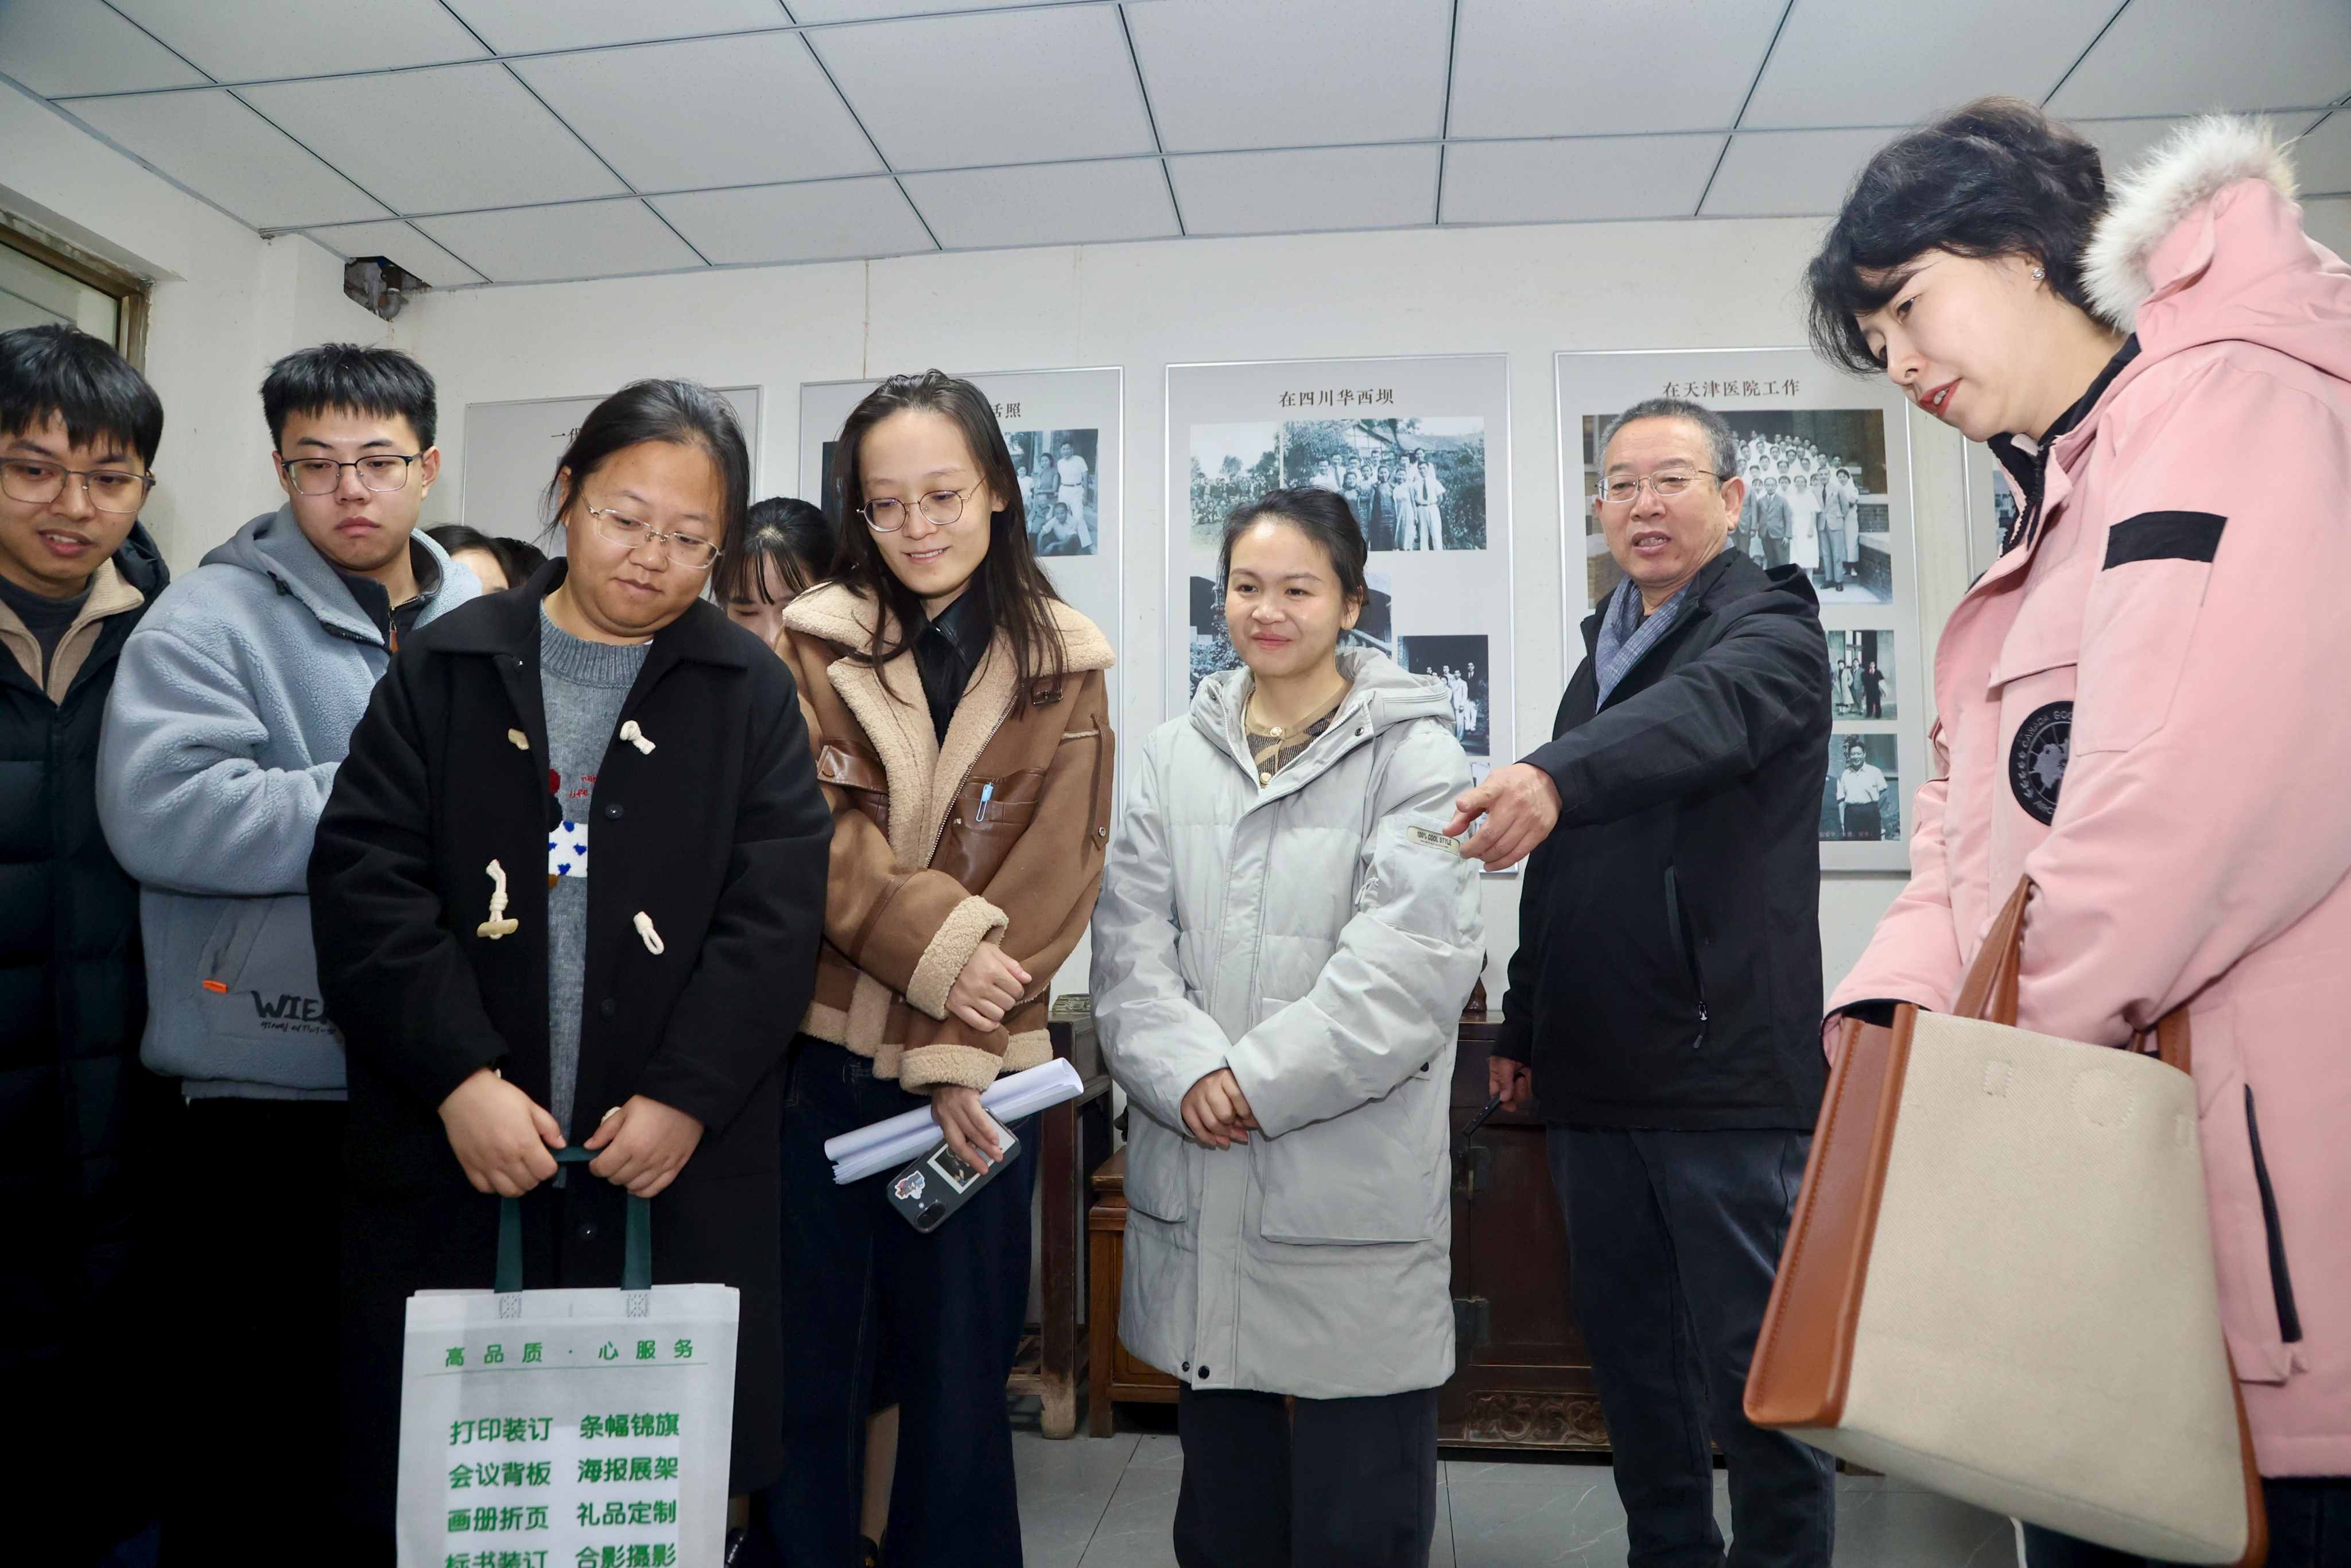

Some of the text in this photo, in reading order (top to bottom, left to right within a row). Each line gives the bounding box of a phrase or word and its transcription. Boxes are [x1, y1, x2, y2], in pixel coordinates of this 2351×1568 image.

[1279, 388, 1395, 408] 在四川华西坝
[1662, 379, 1801, 398] 在天津医院工作
[1417, 830, 1427, 839] 100%
[1427, 834, 1438, 843] COOL
[1439, 836, 1452, 846] STYLE
[449, 1412, 680, 1446] 打印装订 条幅锦旗
[448, 1457, 679, 1489] 会议背板 海报展架
[447, 1500, 678, 1532] 画册折页 礼品定制
